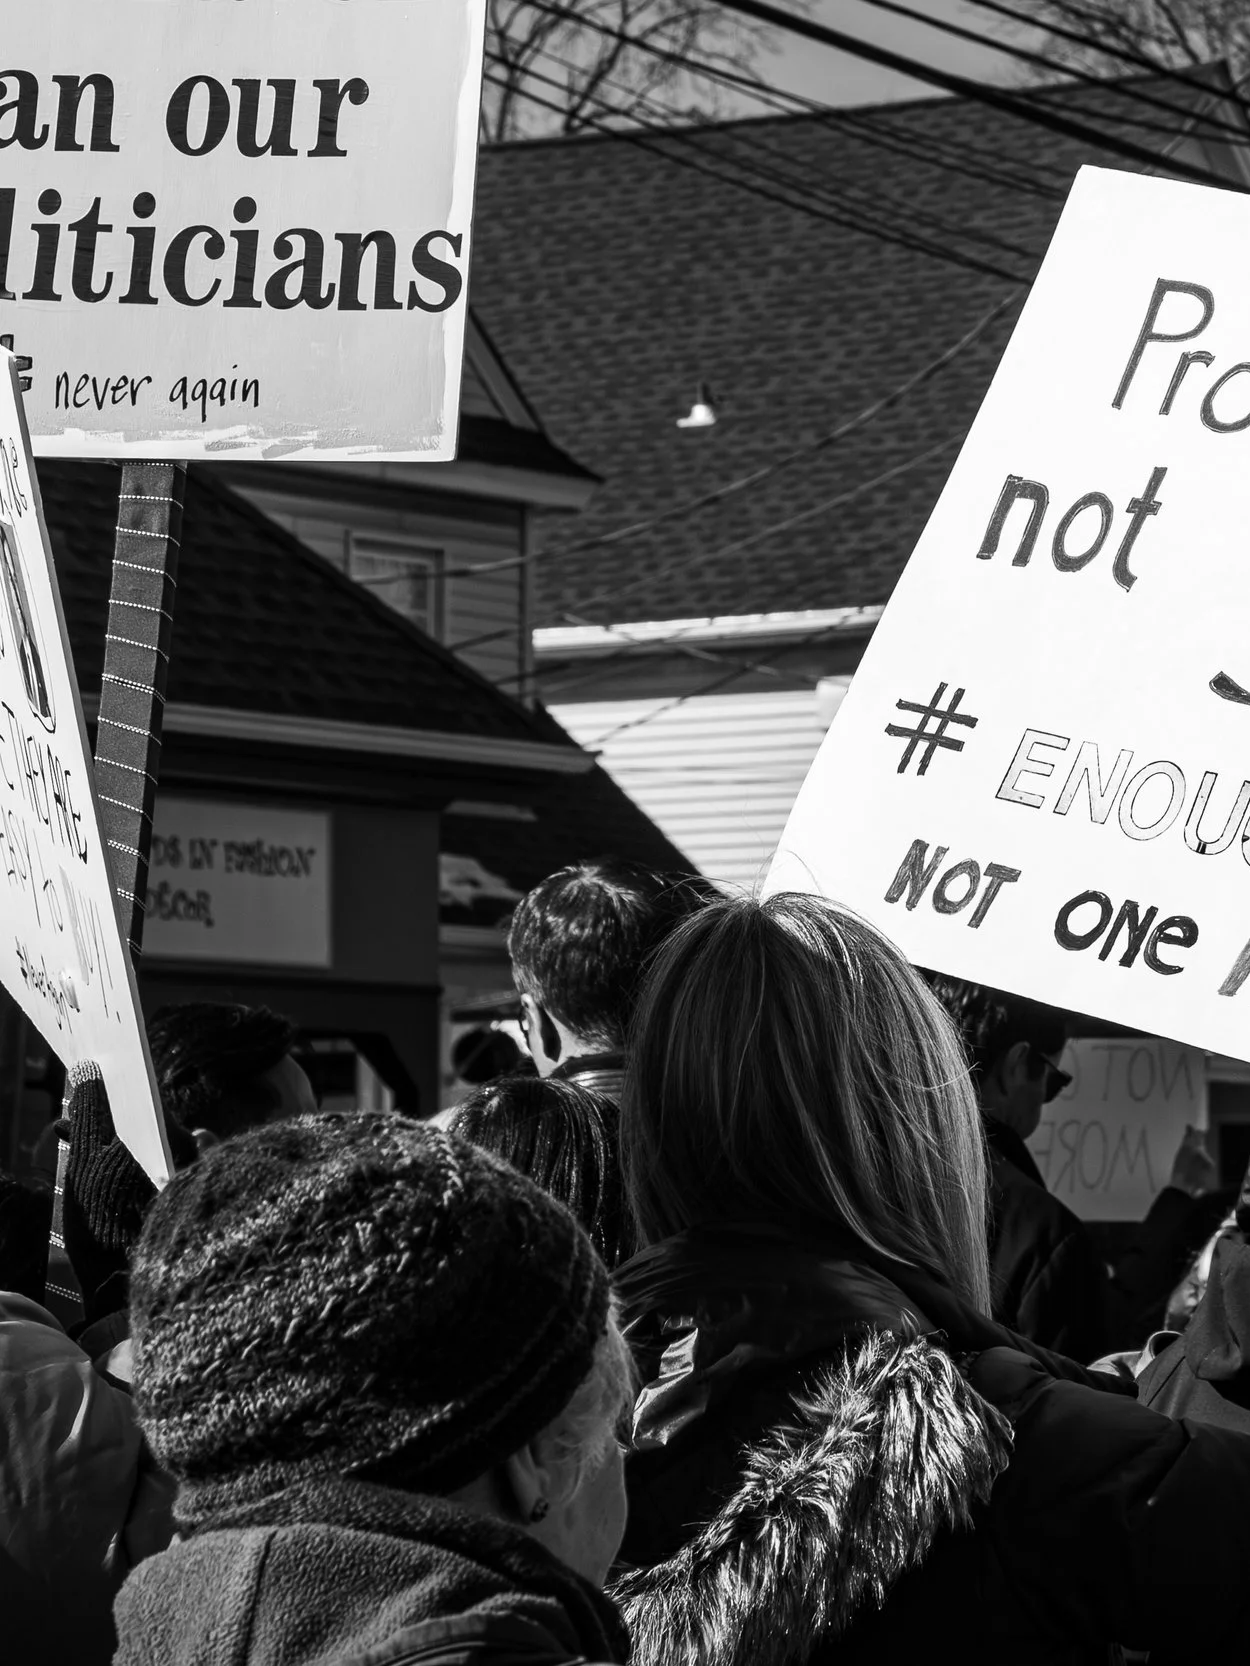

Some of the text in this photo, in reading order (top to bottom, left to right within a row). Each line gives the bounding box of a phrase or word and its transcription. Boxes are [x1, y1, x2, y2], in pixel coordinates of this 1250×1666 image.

[0, 69, 370, 158] an our
[54, 364, 260, 424] never again
[975, 465, 1168, 594] not
[883, 838, 1023, 930] NOT
